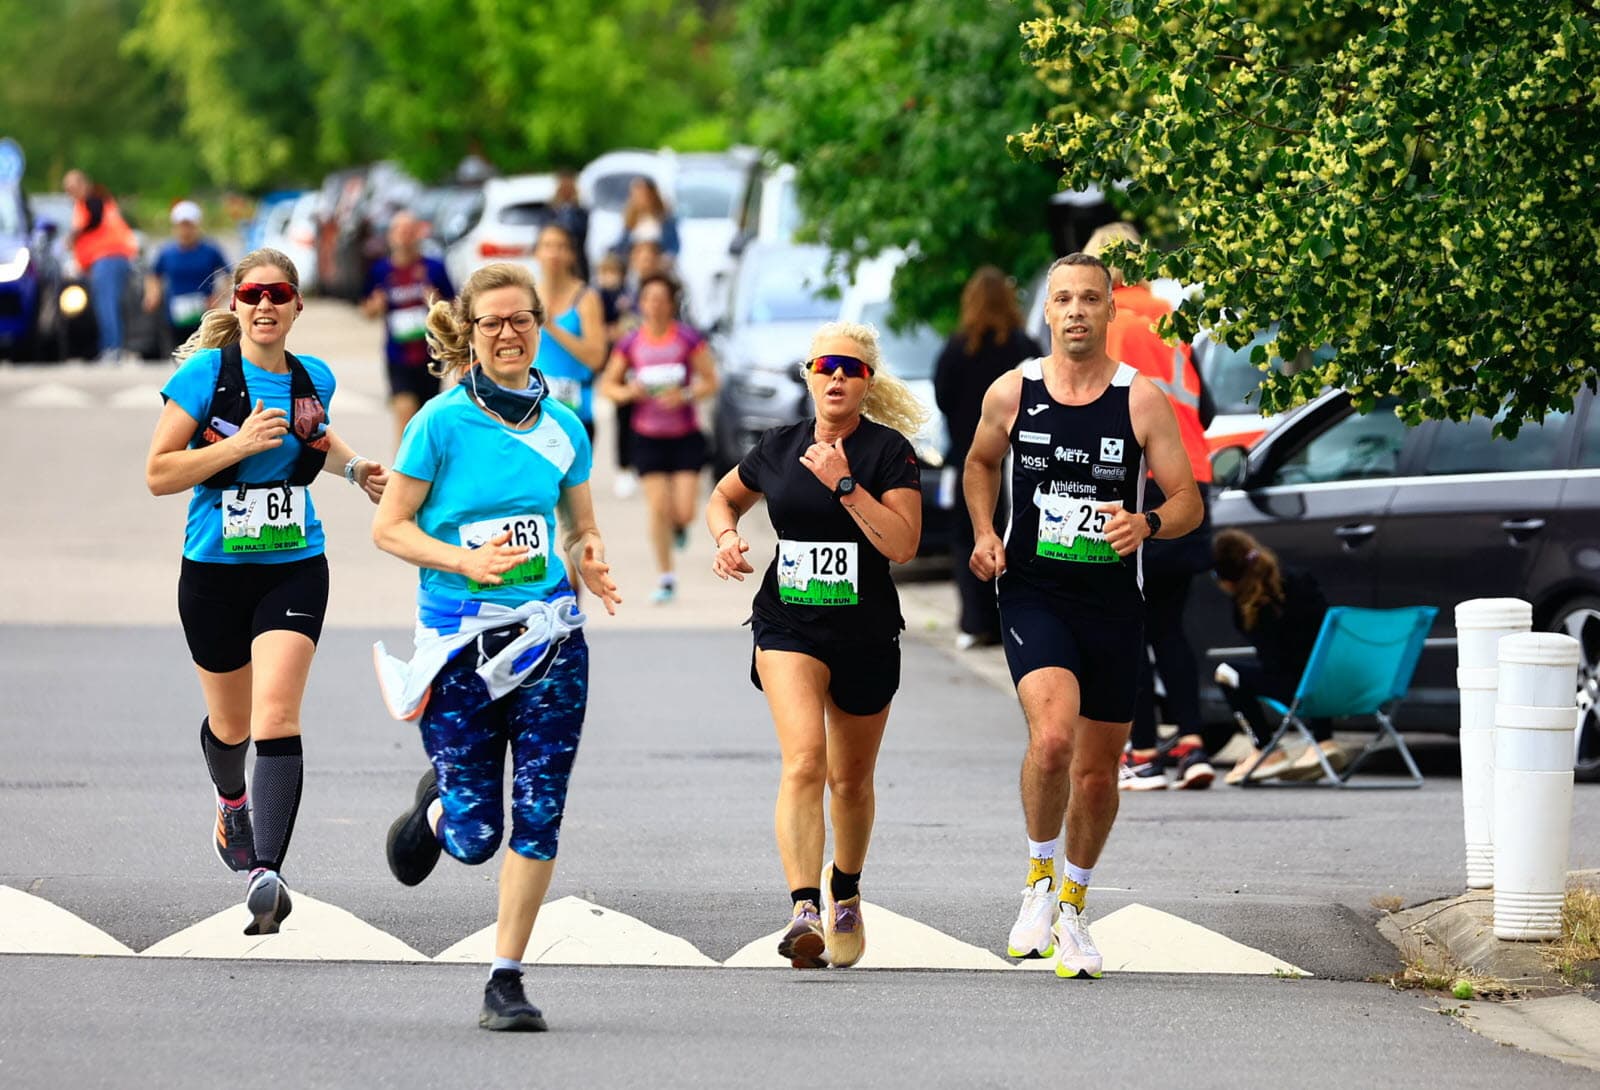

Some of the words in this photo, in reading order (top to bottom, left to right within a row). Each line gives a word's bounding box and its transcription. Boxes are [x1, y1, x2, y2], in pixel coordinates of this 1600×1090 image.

[1020, 453, 1049, 468] MOSL
[1055, 450, 1090, 464] METZ
[1049, 480, 1097, 495] Athlétisme
[267, 492, 293, 520] 64
[503, 519, 540, 549] 163
[809, 547, 848, 576] 128
